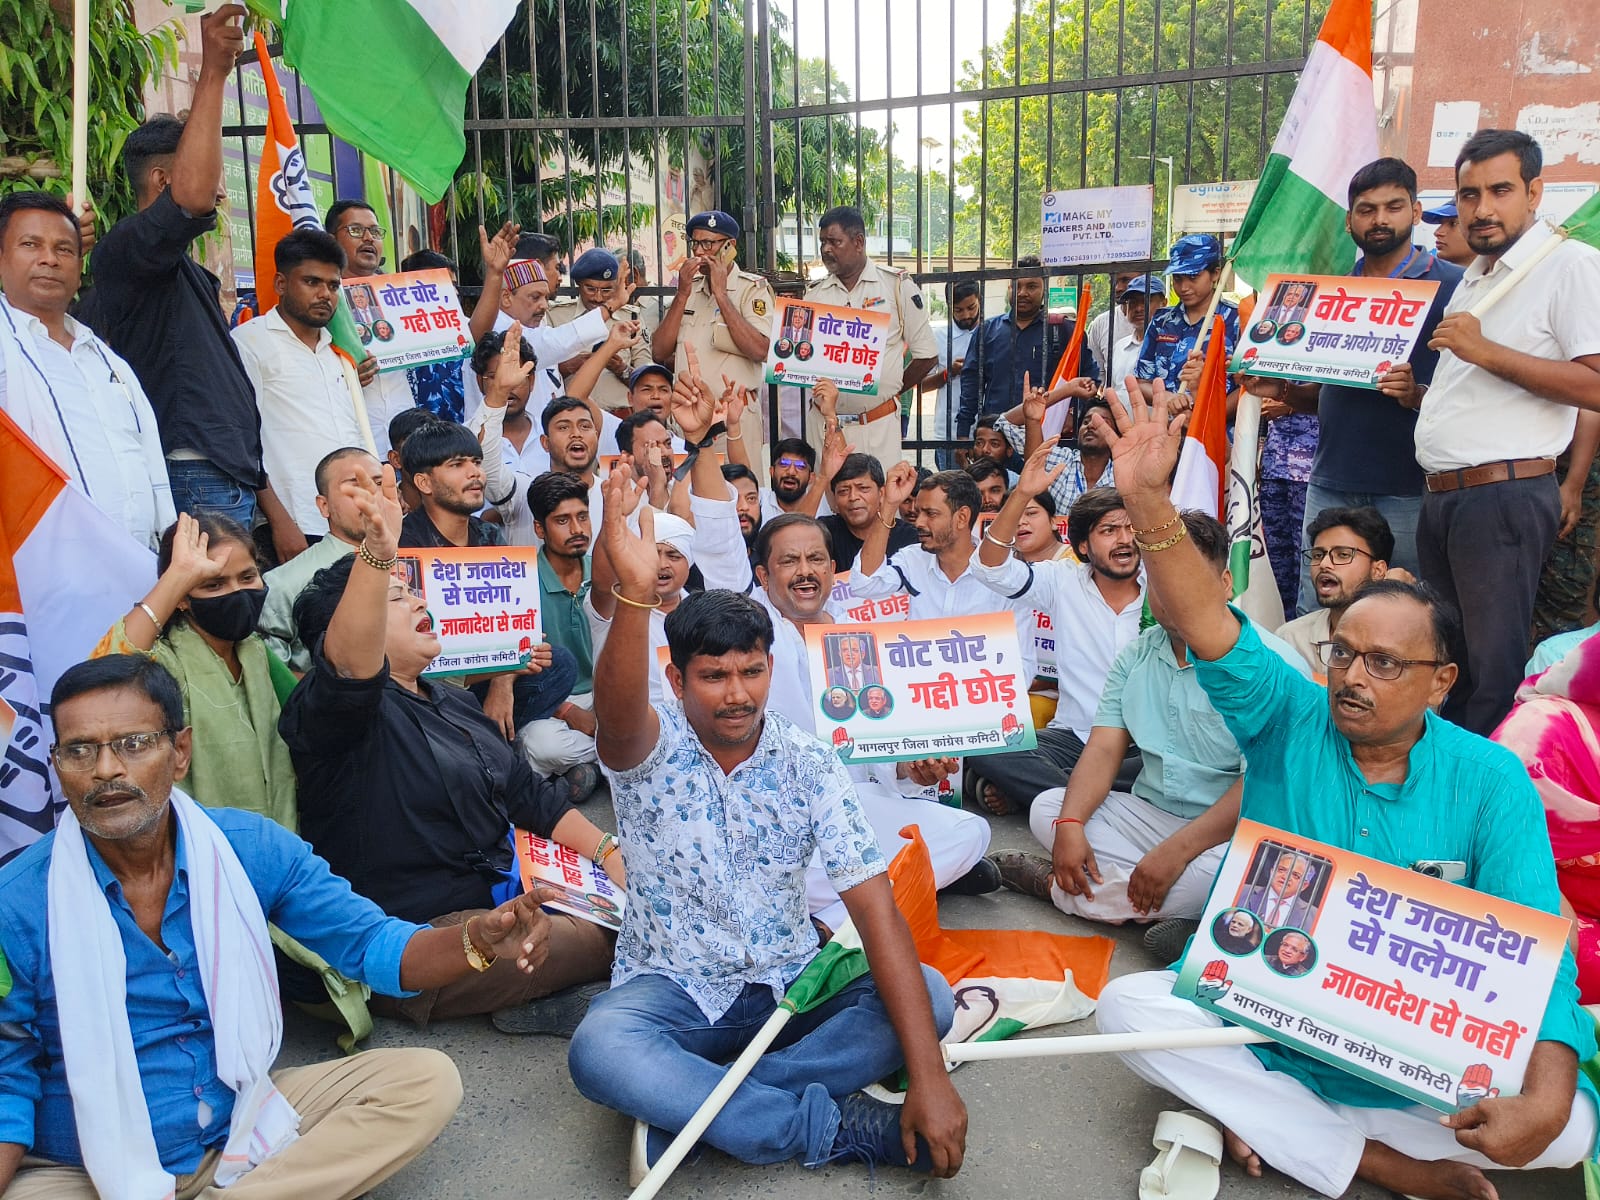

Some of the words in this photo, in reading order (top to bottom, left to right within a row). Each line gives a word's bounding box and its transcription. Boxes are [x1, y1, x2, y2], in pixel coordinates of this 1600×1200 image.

[1043, 223, 1083, 234] PACKERS
[1086, 223, 1105, 231] AND
[1108, 220, 1146, 229] MOVERS
[1063, 211, 1093, 221] MAKE
[1096, 209, 1112, 219] MY
[1095, 231, 1114, 239] LTD.
[380, 282, 410, 306] वोट
[400, 308, 431, 333] गद्दी
[430, 306, 462, 332] छोड़
[1314, 288, 1368, 323] वोट
[1369, 290, 1425, 328] चोर
[819, 313, 845, 336] वोट
[405, 351, 421, 361] जिला
[823, 341, 850, 364] गद्दी
[852, 344, 879, 370] छोड़
[1305, 331, 1340, 352] चुनाव
[1342, 331, 1382, 352] आयोग
[1381, 334, 1409, 359] छोड़
[1291, 361, 1313, 374] जिला
[1343, 368, 1370, 379] कमिटी
[432, 558, 462, 581] देश
[464, 557, 527, 580] जनादेश
[442, 582, 461, 606] से
[878, 594, 911, 621] छोड़
[440, 612, 494, 636] ज्ञानादेश
[496, 610, 509, 632] से
[511, 608, 537, 631] नहीं
[440, 656, 461, 668] जिला
[463, 653, 489, 665] कांग्रेस
[491, 651, 516, 662] कमिटी
[885, 634, 932, 668] वोट
[908, 672, 959, 711] गद्दी
[962, 668, 1017, 708] छोड़
[857, 740, 900, 755] भागलपुर
[902, 735, 929, 751] जिला
[933, 733, 964, 748] कांग्रेस
[967, 729, 1000, 746] कमिटी
[523, 831, 548, 849] चो
[1346, 872, 1403, 922] देश
[1405, 890, 1538, 966] जनादेश
[1348, 918, 1386, 956] से
[1321, 962, 1432, 1025] ज्ञानादेश
[1430, 999, 1462, 1038] से
[1462, 1013, 1527, 1060] नहीं
[1231, 991, 1295, 1030] भागलपुर
[1298, 1016, 1340, 1047] जिला
[1344, 1036, 1394, 1069] कांग्रेस
[1399, 1060, 1453, 1095] कमिटी
